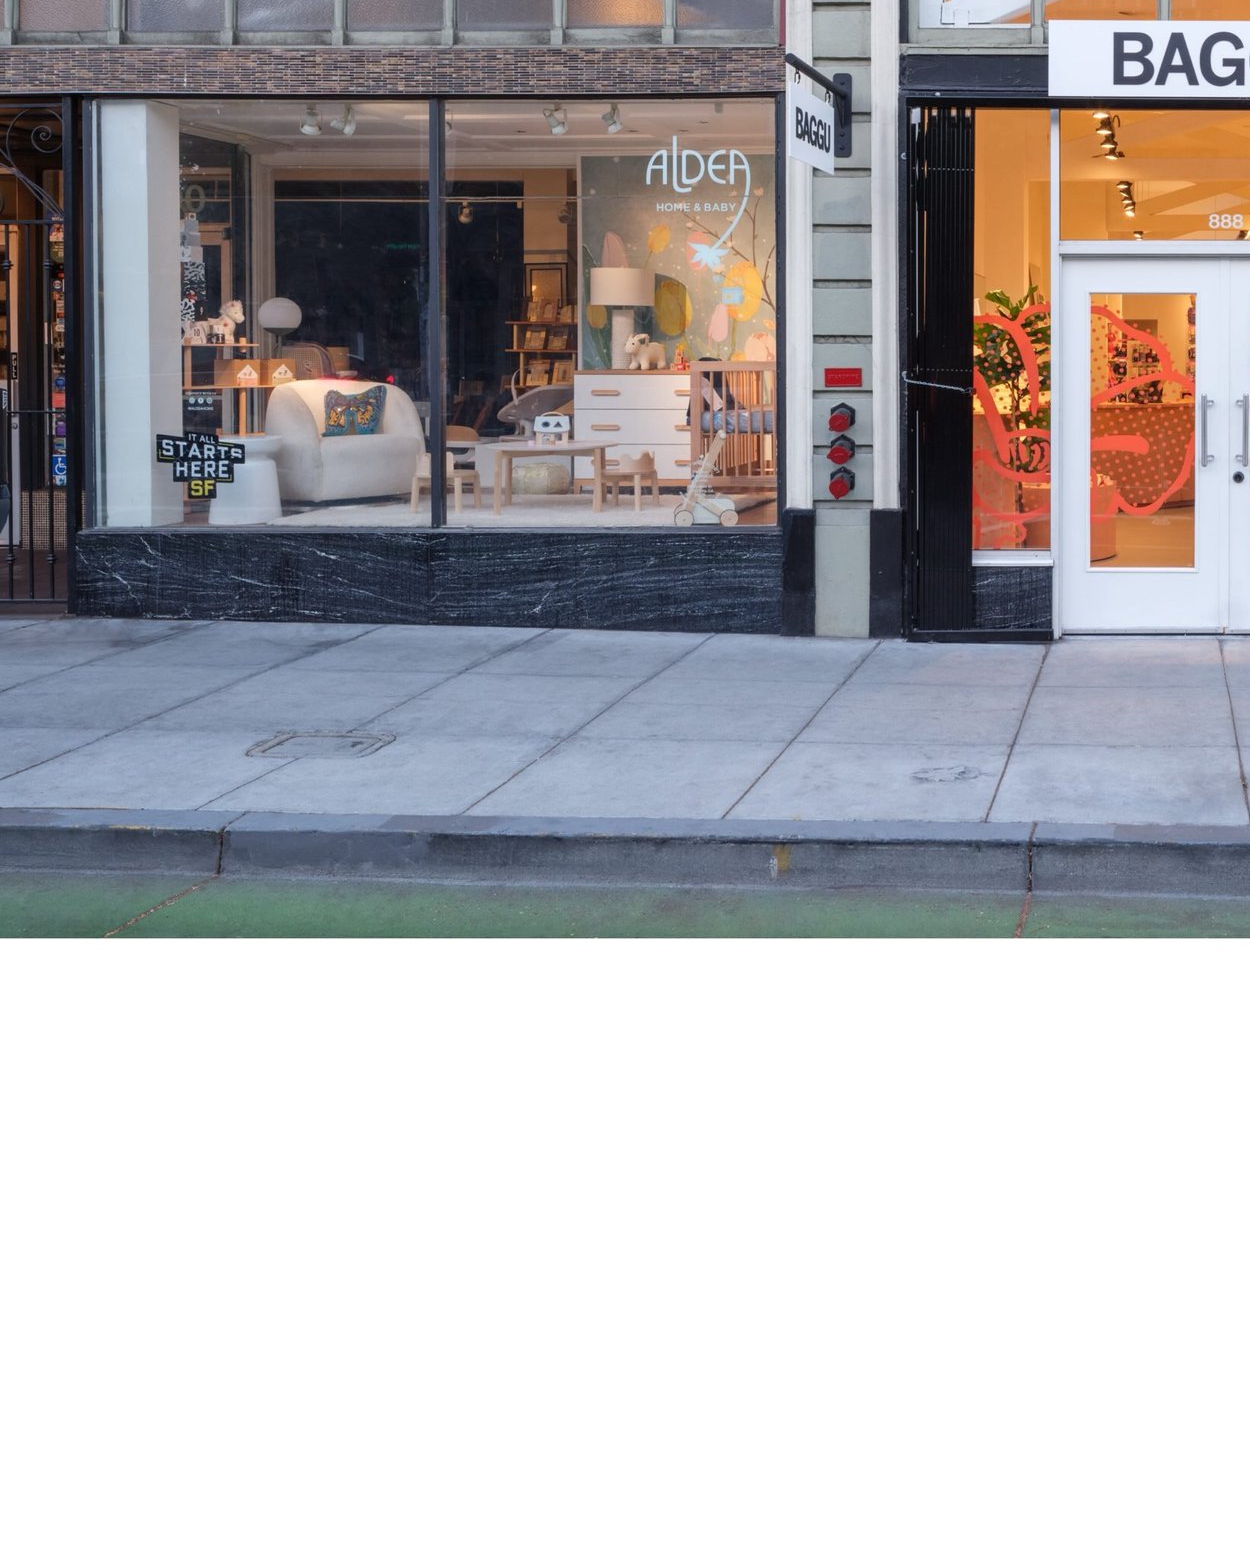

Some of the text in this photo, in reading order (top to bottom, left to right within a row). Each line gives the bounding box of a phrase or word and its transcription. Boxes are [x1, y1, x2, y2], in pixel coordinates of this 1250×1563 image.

[795, 106, 831, 153] BAGGU
[656, 203, 736, 212] HOME & BABY
[1208, 214, 1244, 229] 888
[199, 435, 216, 444] ALL
[162, 439, 242, 459] STARTS
[176, 460, 229, 478] HERE
[191, 480, 215, 496] SF
